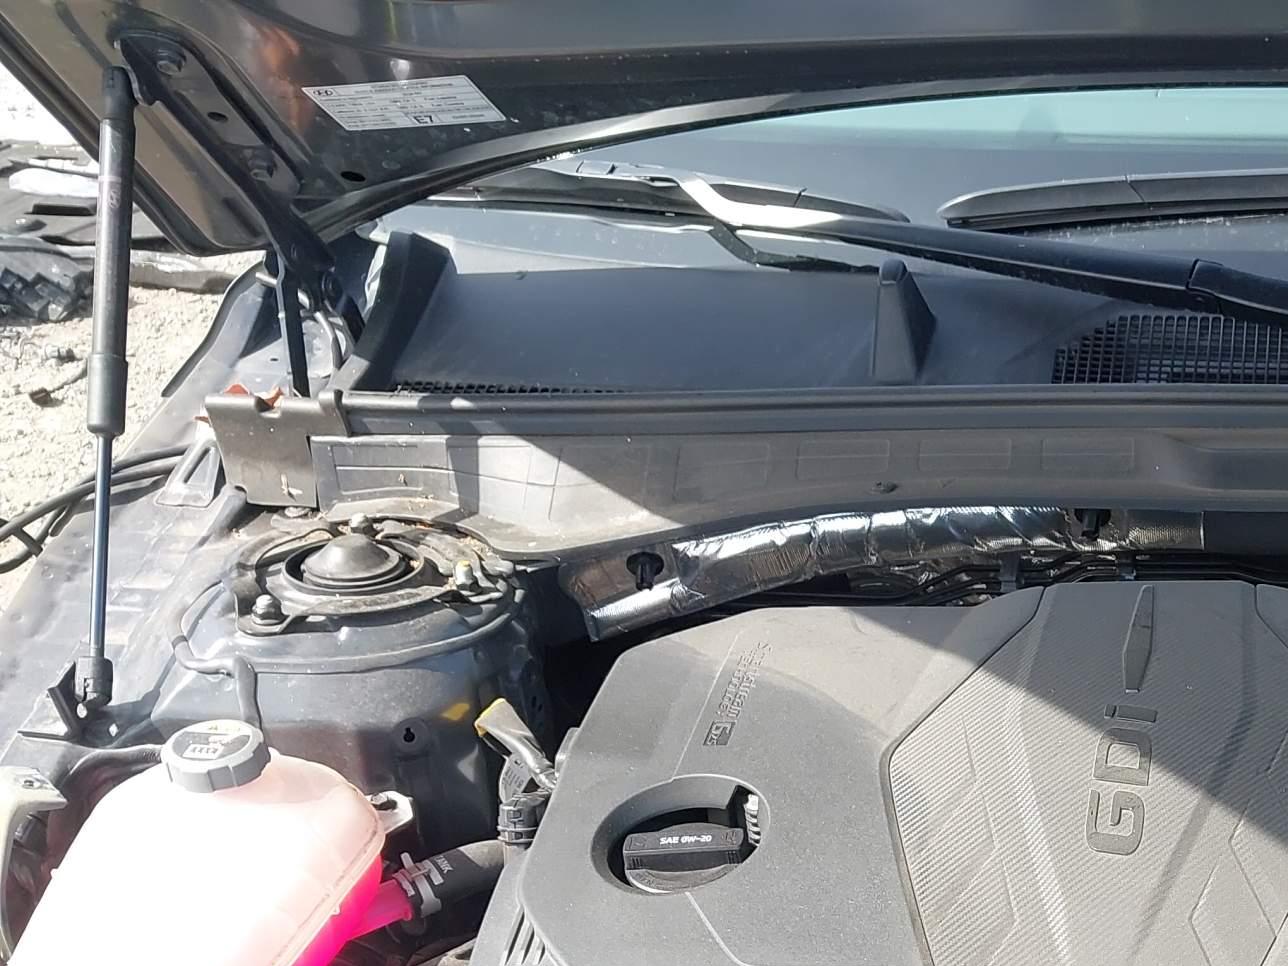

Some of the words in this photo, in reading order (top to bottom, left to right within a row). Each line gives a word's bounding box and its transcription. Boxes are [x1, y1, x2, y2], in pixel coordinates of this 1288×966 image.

[1086, 704, 1158, 857] GDi
[660, 836, 680, 845] SAE
[681, 834, 713, 844] 0W-20
